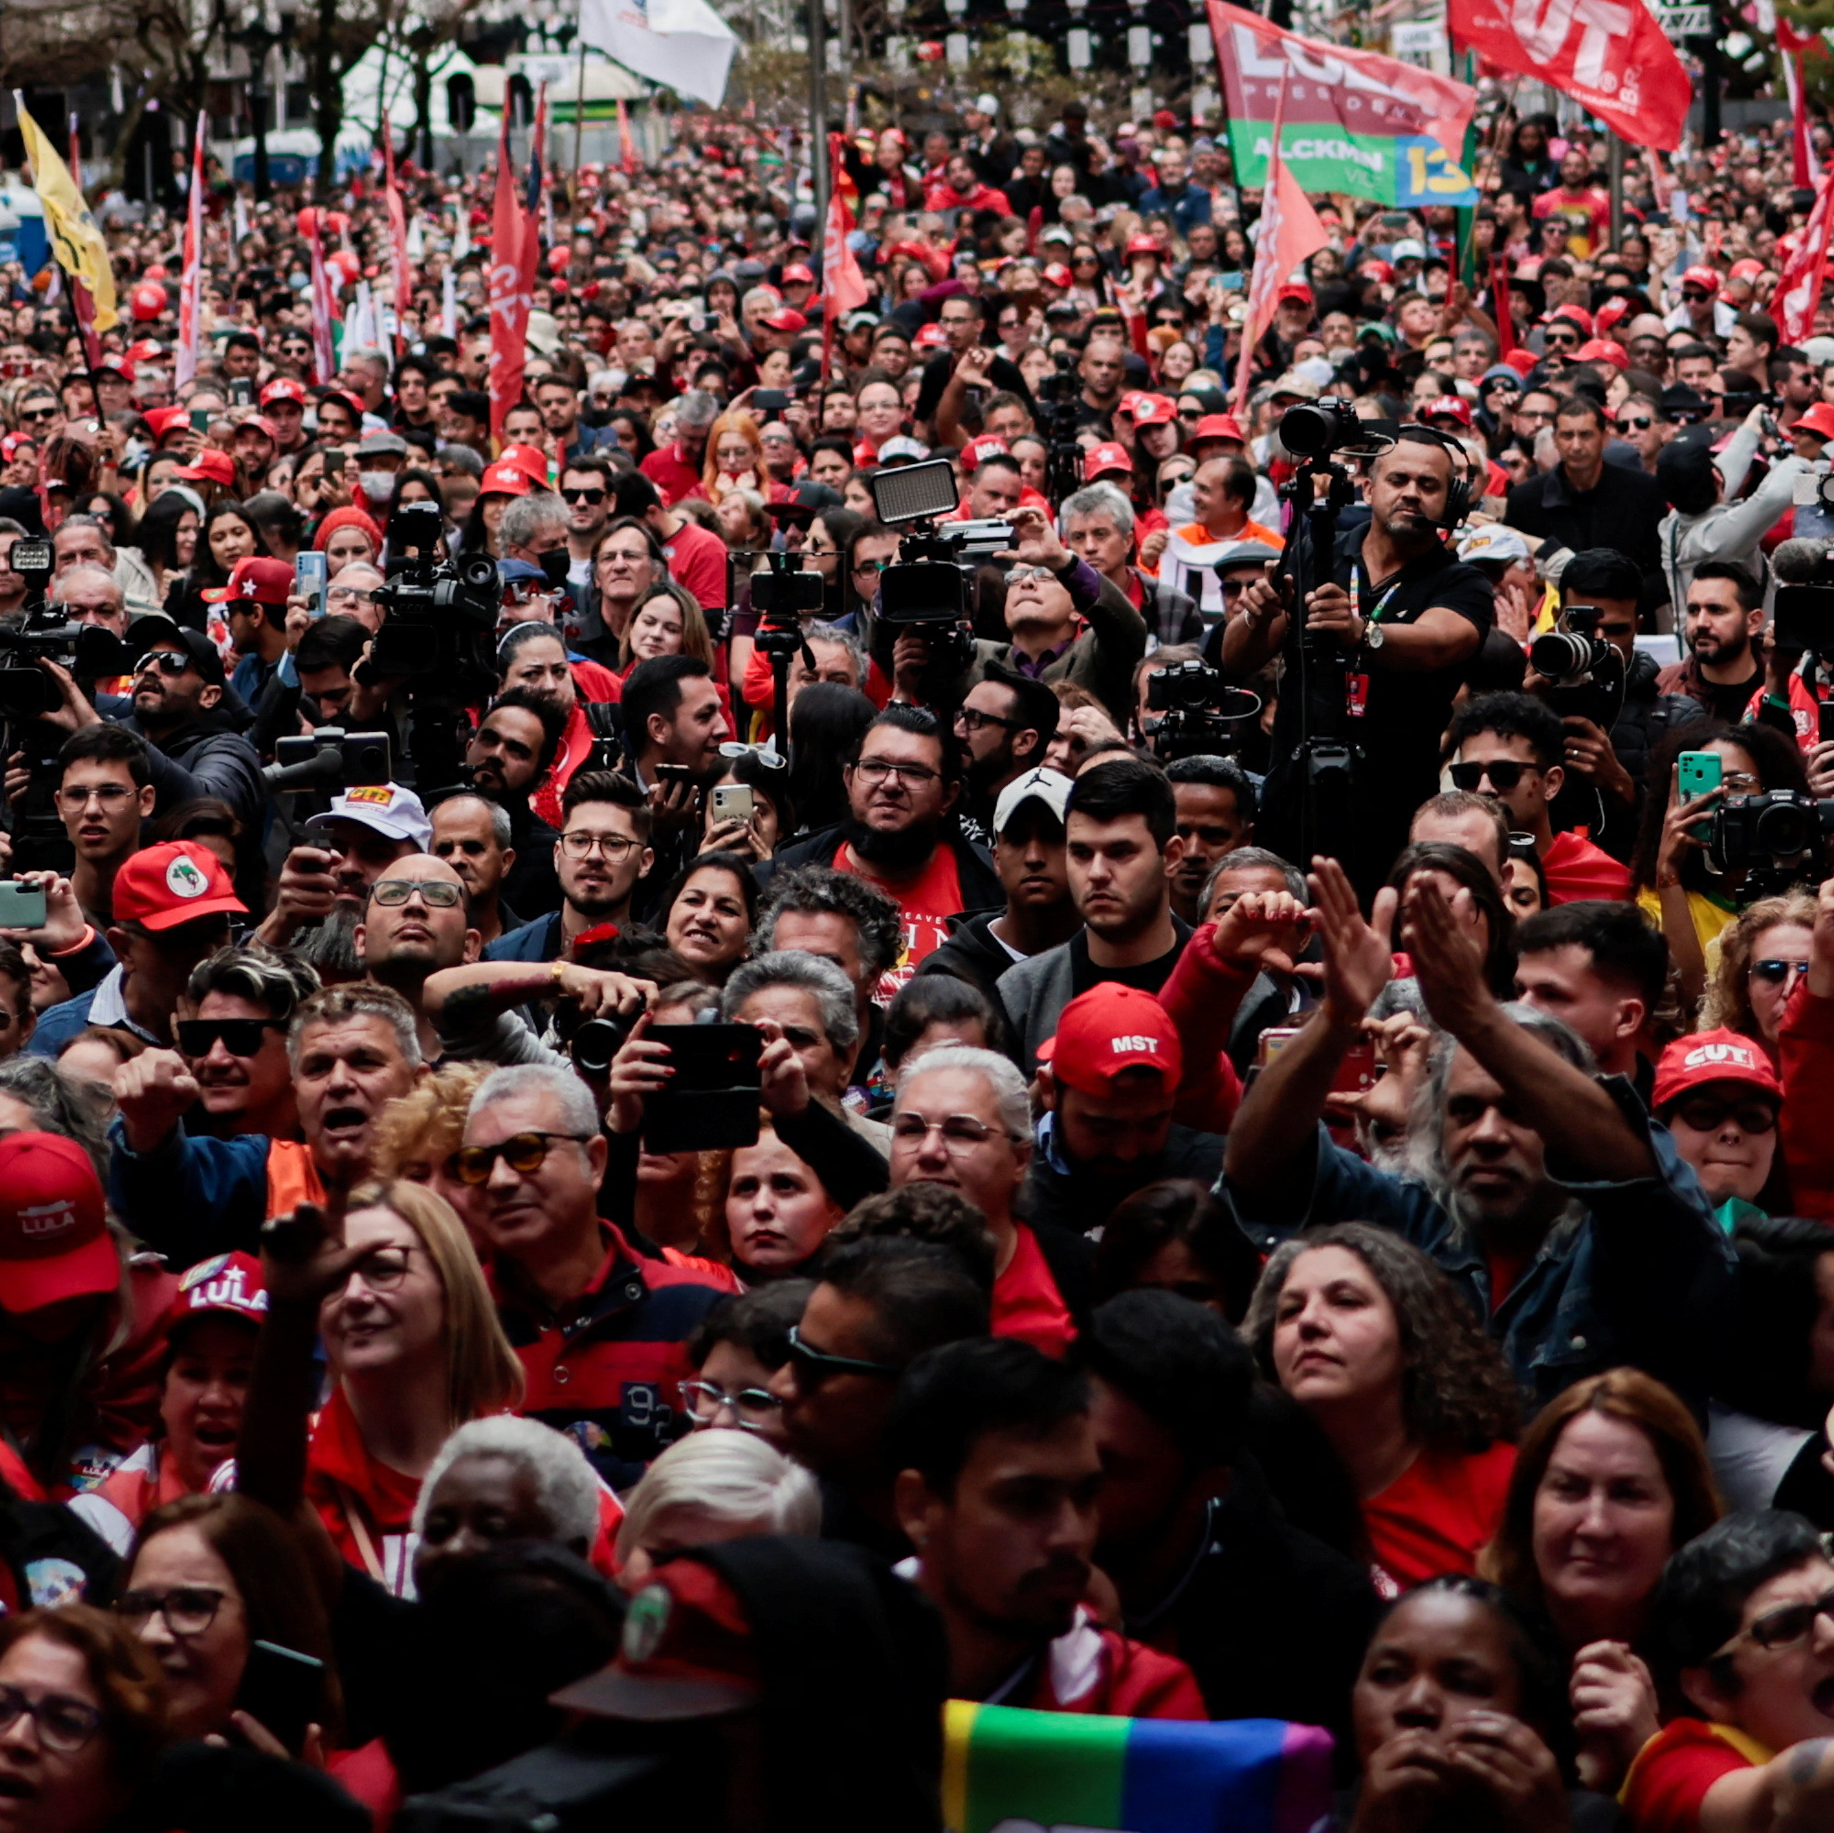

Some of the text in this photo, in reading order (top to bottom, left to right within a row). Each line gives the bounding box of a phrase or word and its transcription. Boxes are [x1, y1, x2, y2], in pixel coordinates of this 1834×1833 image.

[1111, 1034, 1158, 1054] MST
[1684, 1042, 1748, 1066] CUT
[22, 1209, 75, 1235] LULA
[190, 1279, 270, 1312] LULA
